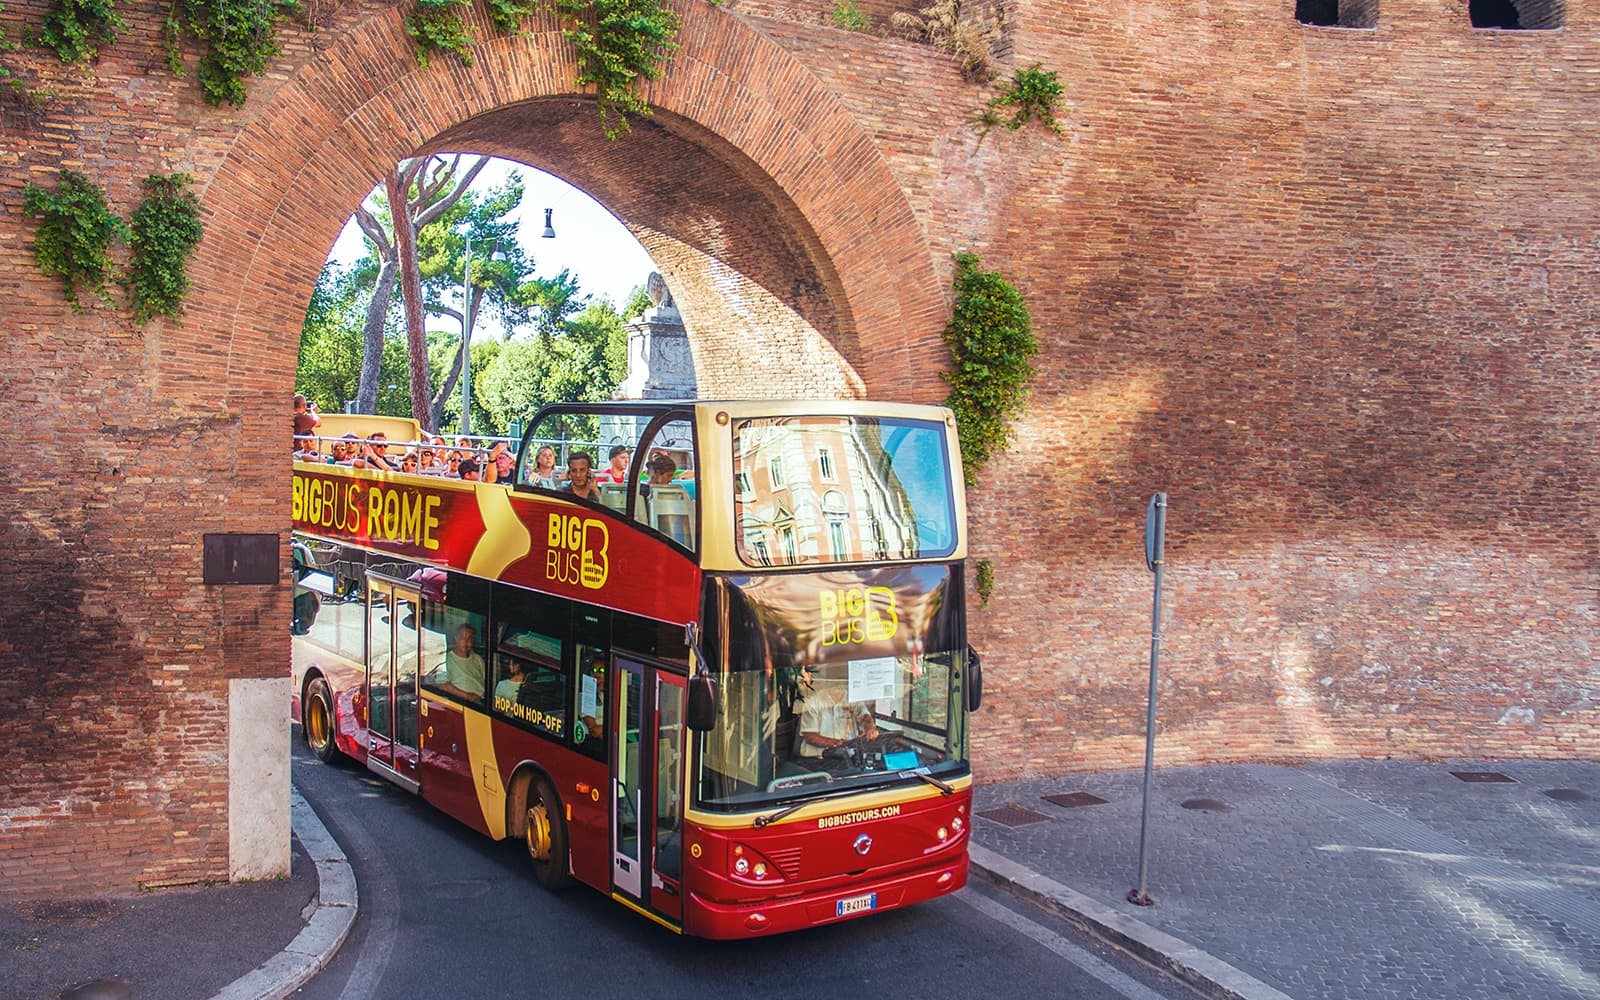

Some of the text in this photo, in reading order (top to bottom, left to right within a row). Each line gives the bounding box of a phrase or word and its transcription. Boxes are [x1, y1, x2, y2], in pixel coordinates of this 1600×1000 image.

[292, 475, 441, 551] BIGBUS ROME
[548, 512, 582, 551] BIG
[545, 549, 580, 585] BUS
[819, 590, 864, 619] BIG
[822, 618, 865, 646] BUS
[494, 695, 563, 733] HOP-ON HOP-OFF
[818, 805, 900, 828] BIGBUSTOURS.COM
